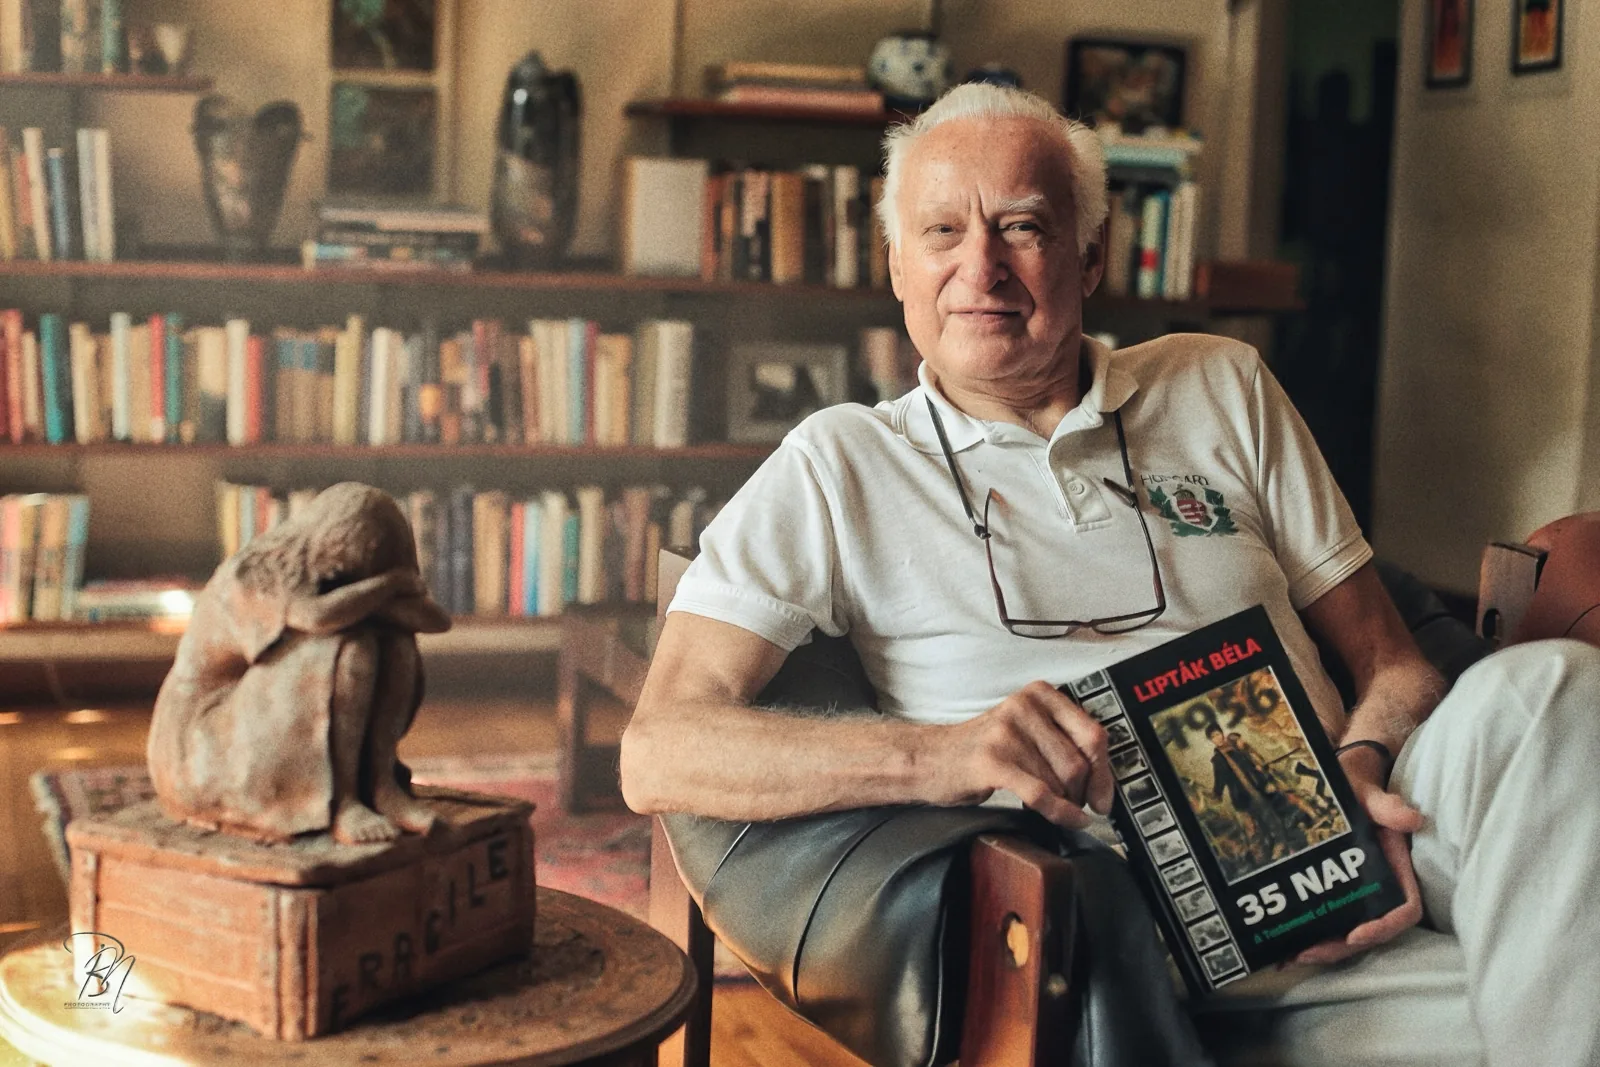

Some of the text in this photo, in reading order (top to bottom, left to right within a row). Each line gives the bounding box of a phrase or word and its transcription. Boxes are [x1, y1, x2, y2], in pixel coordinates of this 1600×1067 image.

[1133, 637, 1263, 702] LIPTÁK BÉLA
[1236, 847, 1366, 926] 35 NAP
[328, 838, 509, 1032] FRAGILE
